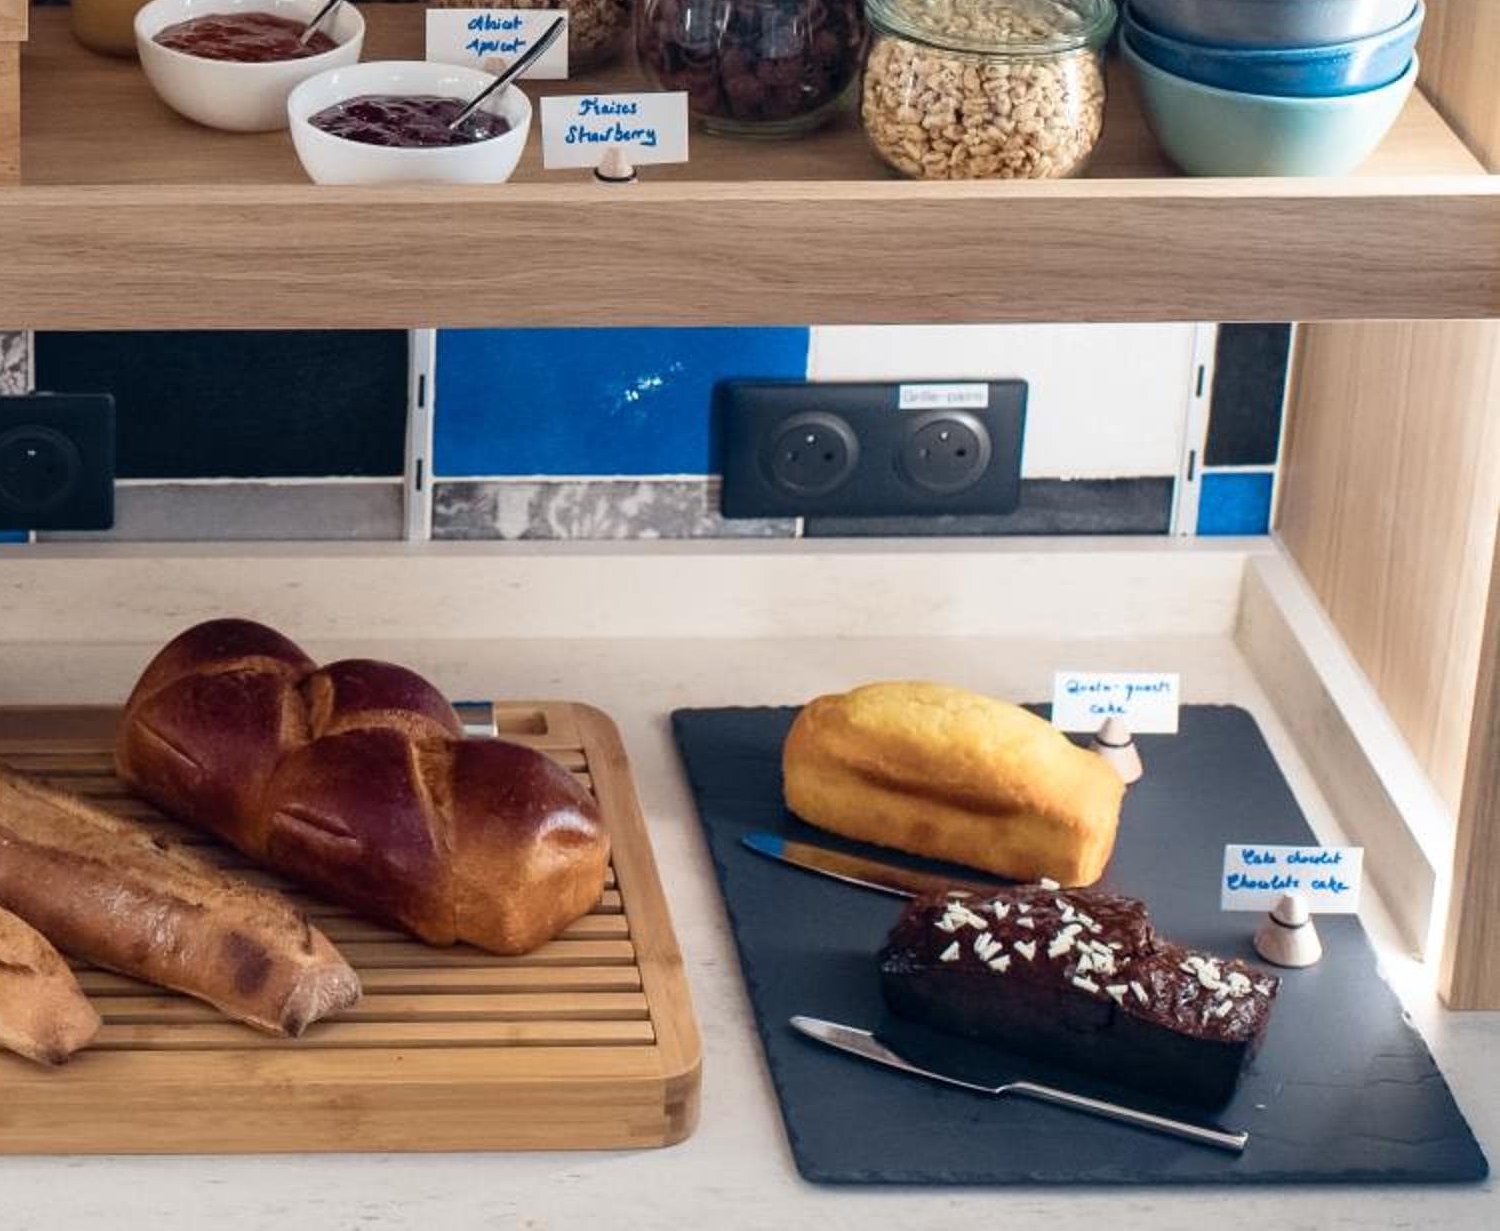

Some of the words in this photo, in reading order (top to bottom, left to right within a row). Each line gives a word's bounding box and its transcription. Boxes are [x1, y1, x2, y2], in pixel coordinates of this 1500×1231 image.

[467, 13, 523, 32] Abricot
[465, 37, 527, 57] Apricot
[579, 97, 637, 116] Fraises
[565, 122, 657, 146] Strawberry
[1242, 849, 1277, 865] Cake
[1287, 851, 1342, 865] chocolat
[1227, 873, 1300, 891] Chocolate
[1311, 874, 1349, 893] cake
